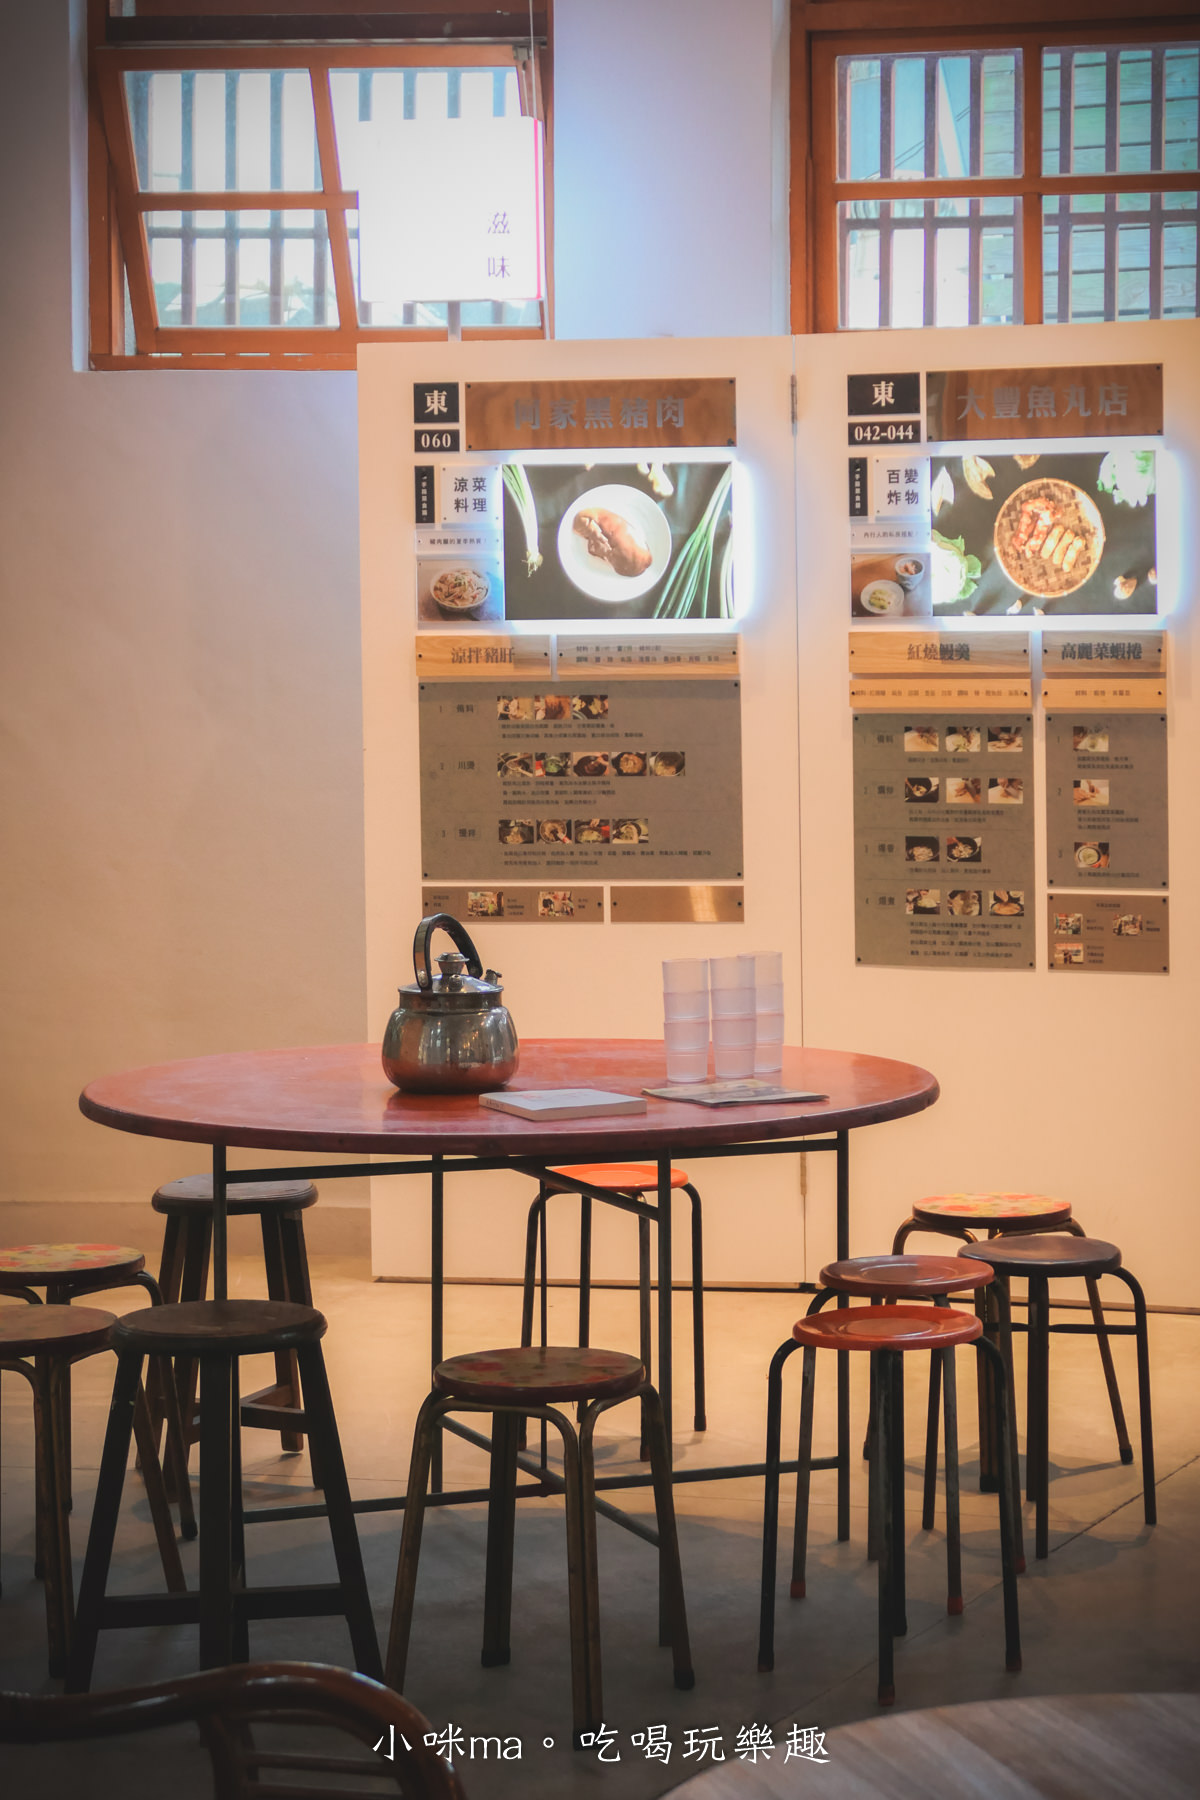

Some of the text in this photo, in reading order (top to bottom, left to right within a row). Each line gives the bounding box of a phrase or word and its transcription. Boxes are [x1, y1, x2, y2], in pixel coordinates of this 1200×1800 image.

[424, 390, 448, 415] 東
[872, 381, 895, 406] 東
[957, 383, 1129, 420] 大豐魚丸店
[421, 433, 452, 448] 060
[854, 424, 914, 440] 042-044
[886, 468, 919, 484] 百變
[454, 497, 487, 513] 料理
[887, 489, 919, 506] 炸物
[451, 646, 516, 665] 涼拌豬肝
[1060, 642, 1143, 661] 高麗菜蝦捲
